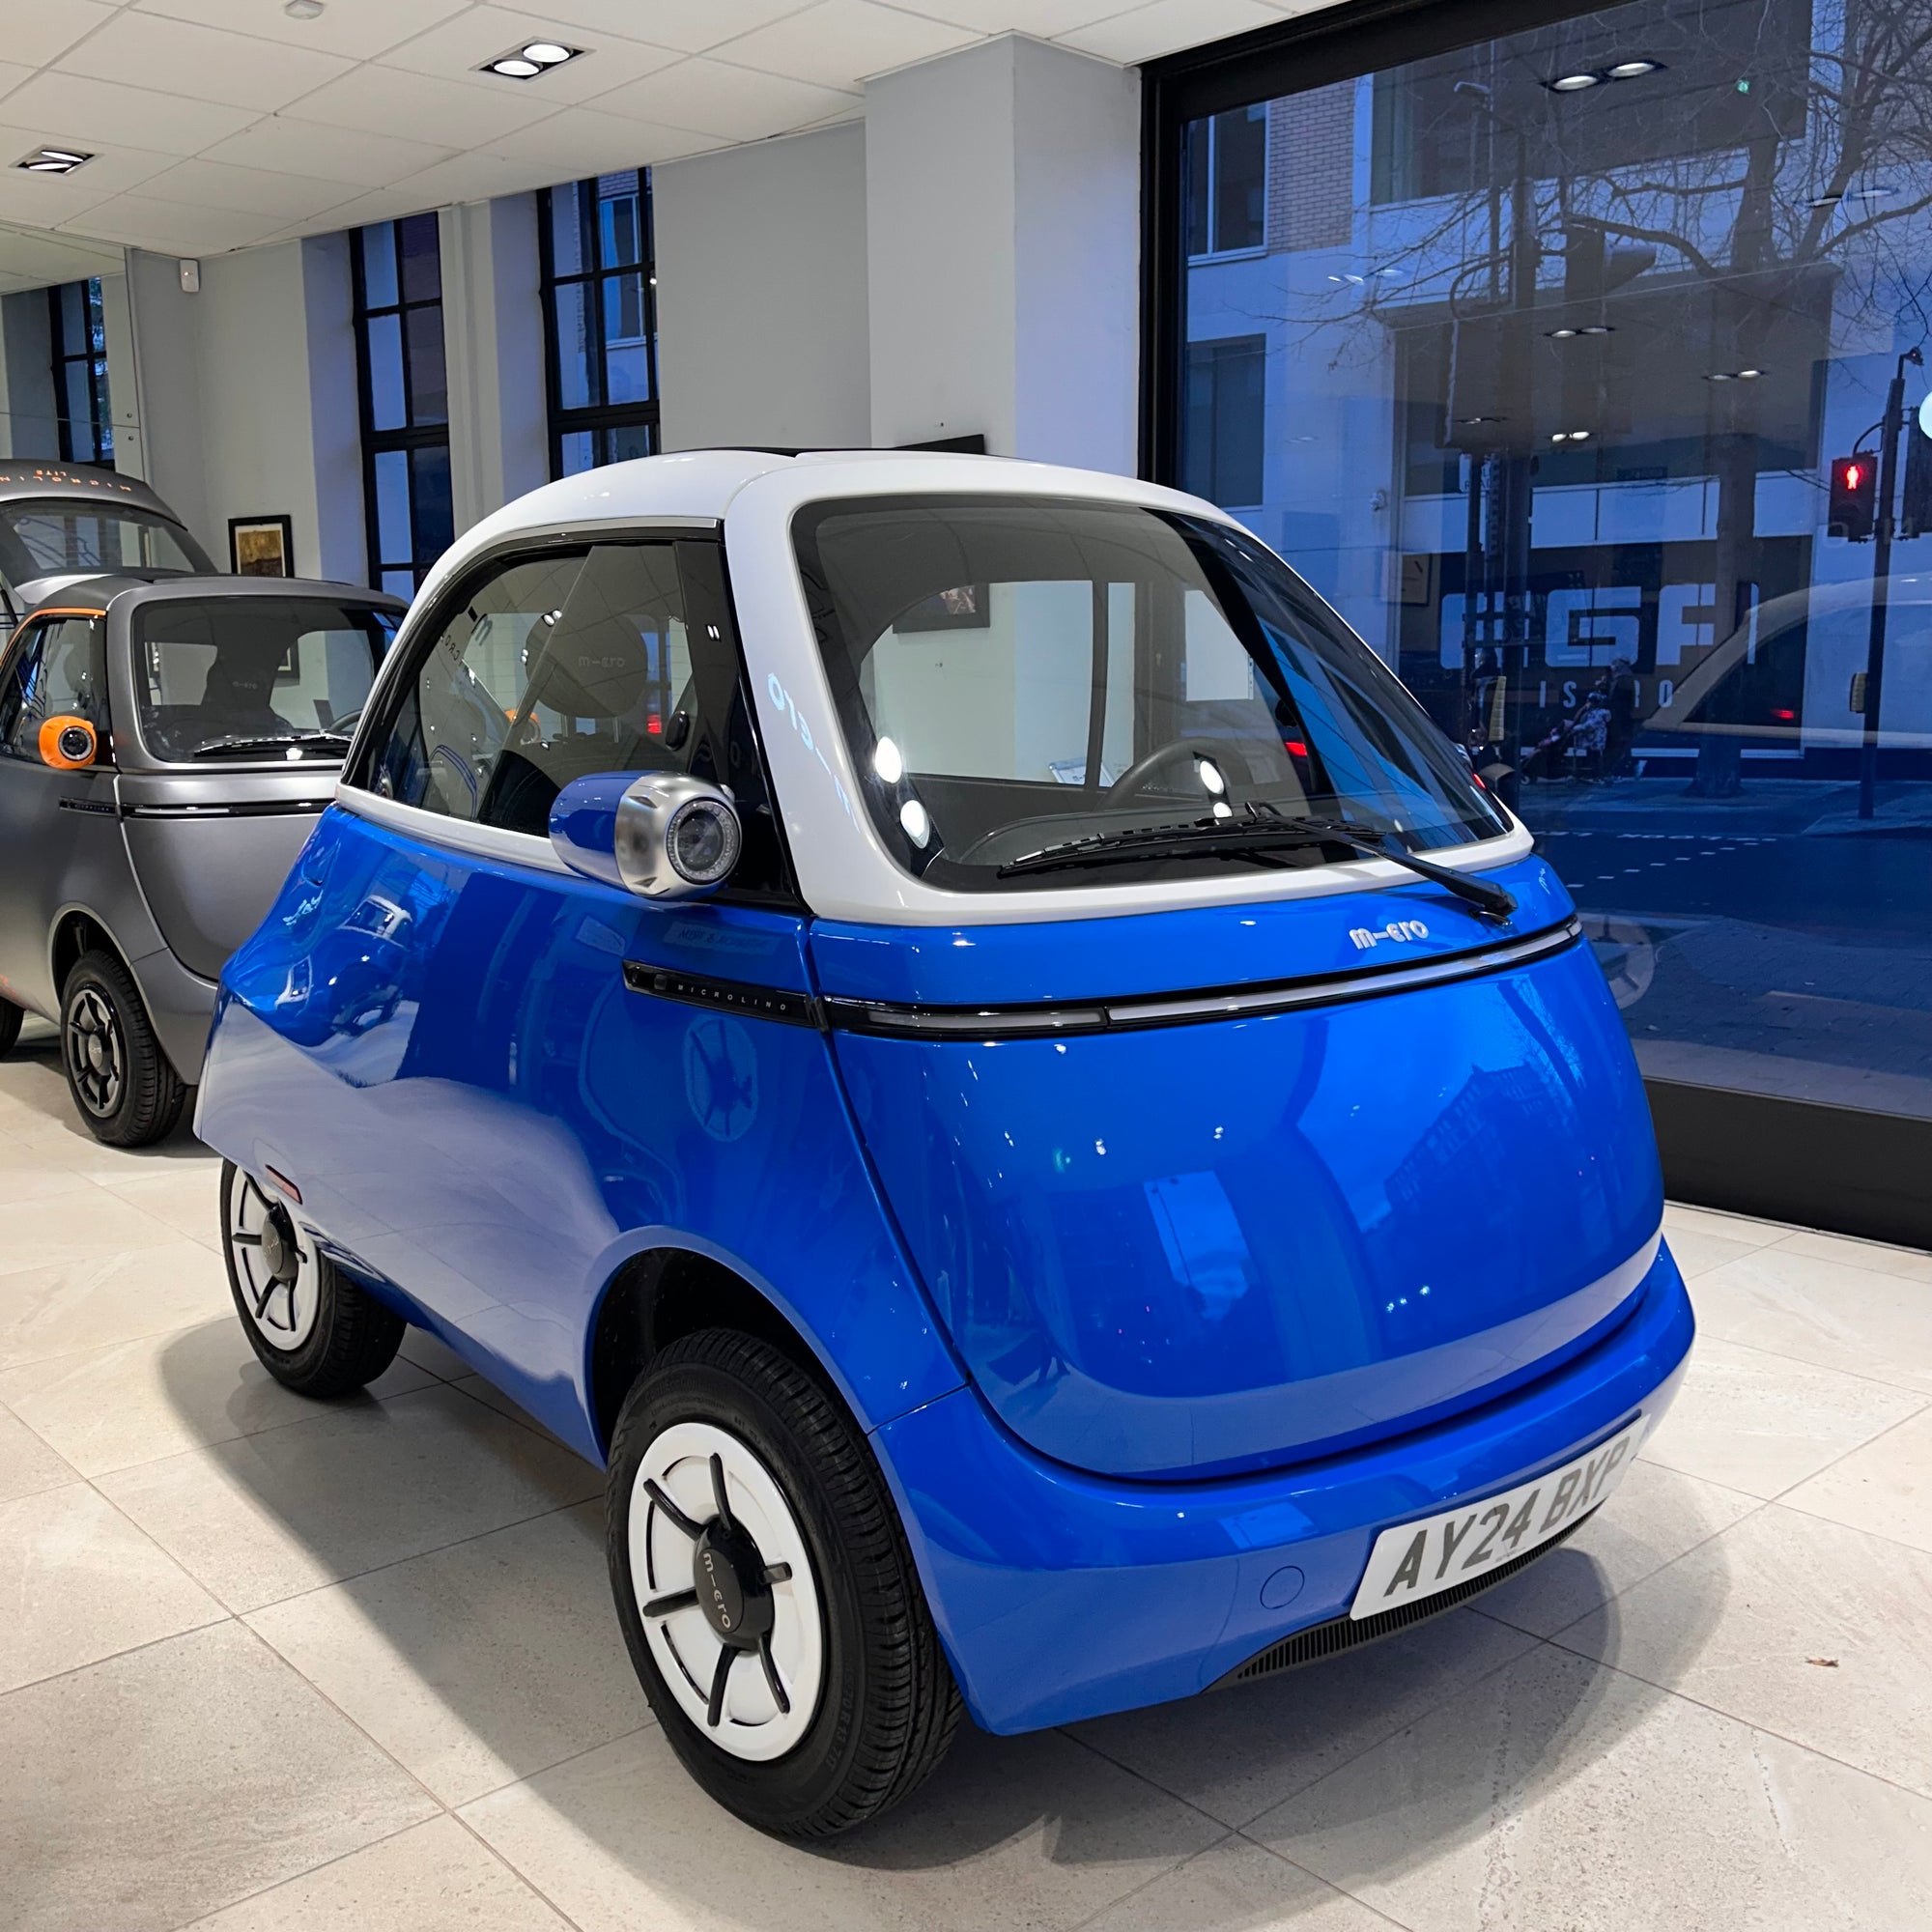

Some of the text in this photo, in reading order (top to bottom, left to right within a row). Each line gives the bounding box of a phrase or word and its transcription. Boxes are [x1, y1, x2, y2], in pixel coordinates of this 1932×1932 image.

[677, 983, 786, 1011] MICROLINO
[1383, 1435, 1631, 1598] AY24 BXP
